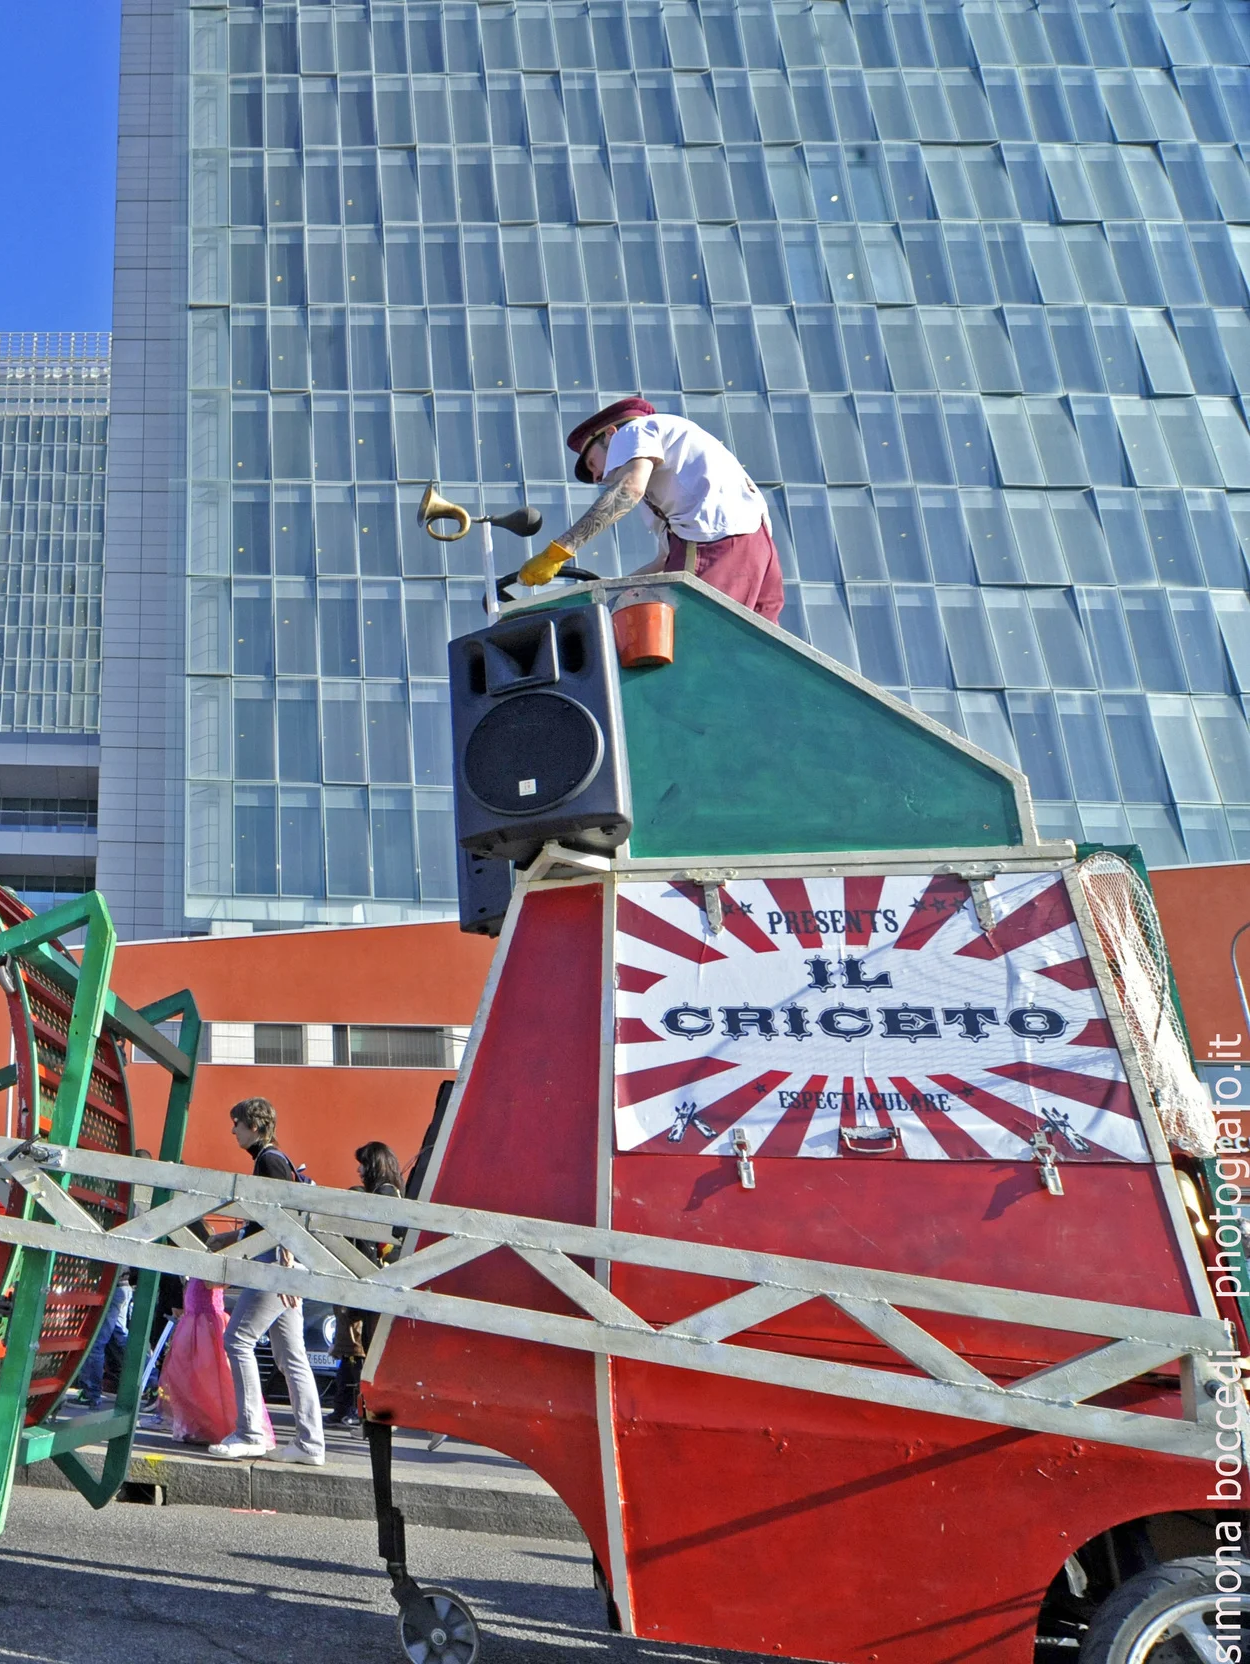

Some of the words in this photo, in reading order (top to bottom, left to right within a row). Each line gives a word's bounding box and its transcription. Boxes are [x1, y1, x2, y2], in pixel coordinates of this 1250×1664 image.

[768, 908, 900, 936] PRESENTS
[803, 953, 893, 993] IL
[660, 1001, 1069, 1044] CRICETO
[778, 1090, 952, 1114] ESPECTACULARE
